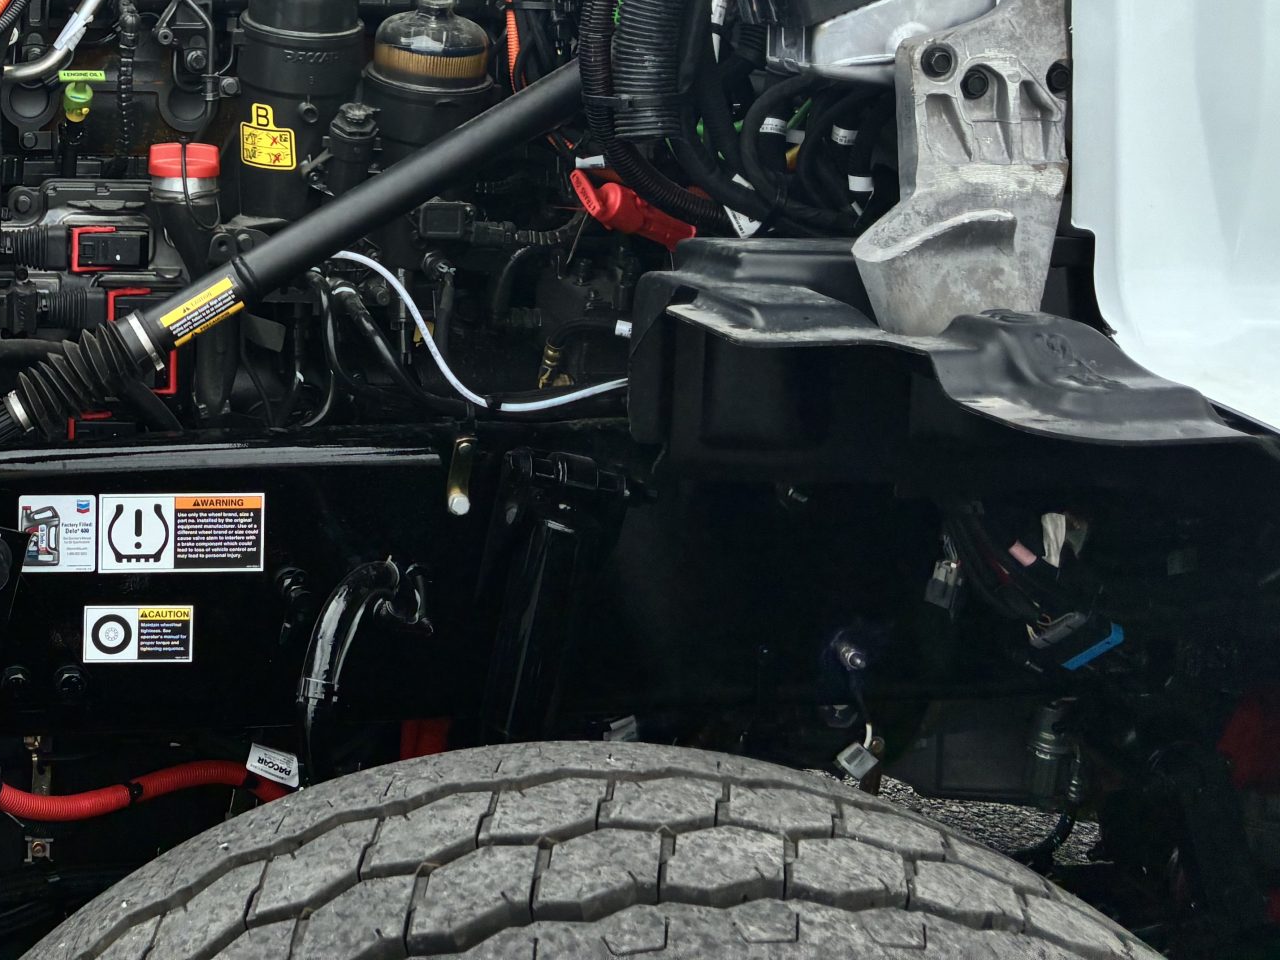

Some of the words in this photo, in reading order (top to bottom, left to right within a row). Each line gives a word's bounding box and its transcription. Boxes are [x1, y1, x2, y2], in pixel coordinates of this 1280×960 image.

[255, 107, 270, 127] B
[200, 499, 244, 507] WARNING
[148, 610, 189, 618] CAUTION
[257, 756, 292, 777] PACCAR
